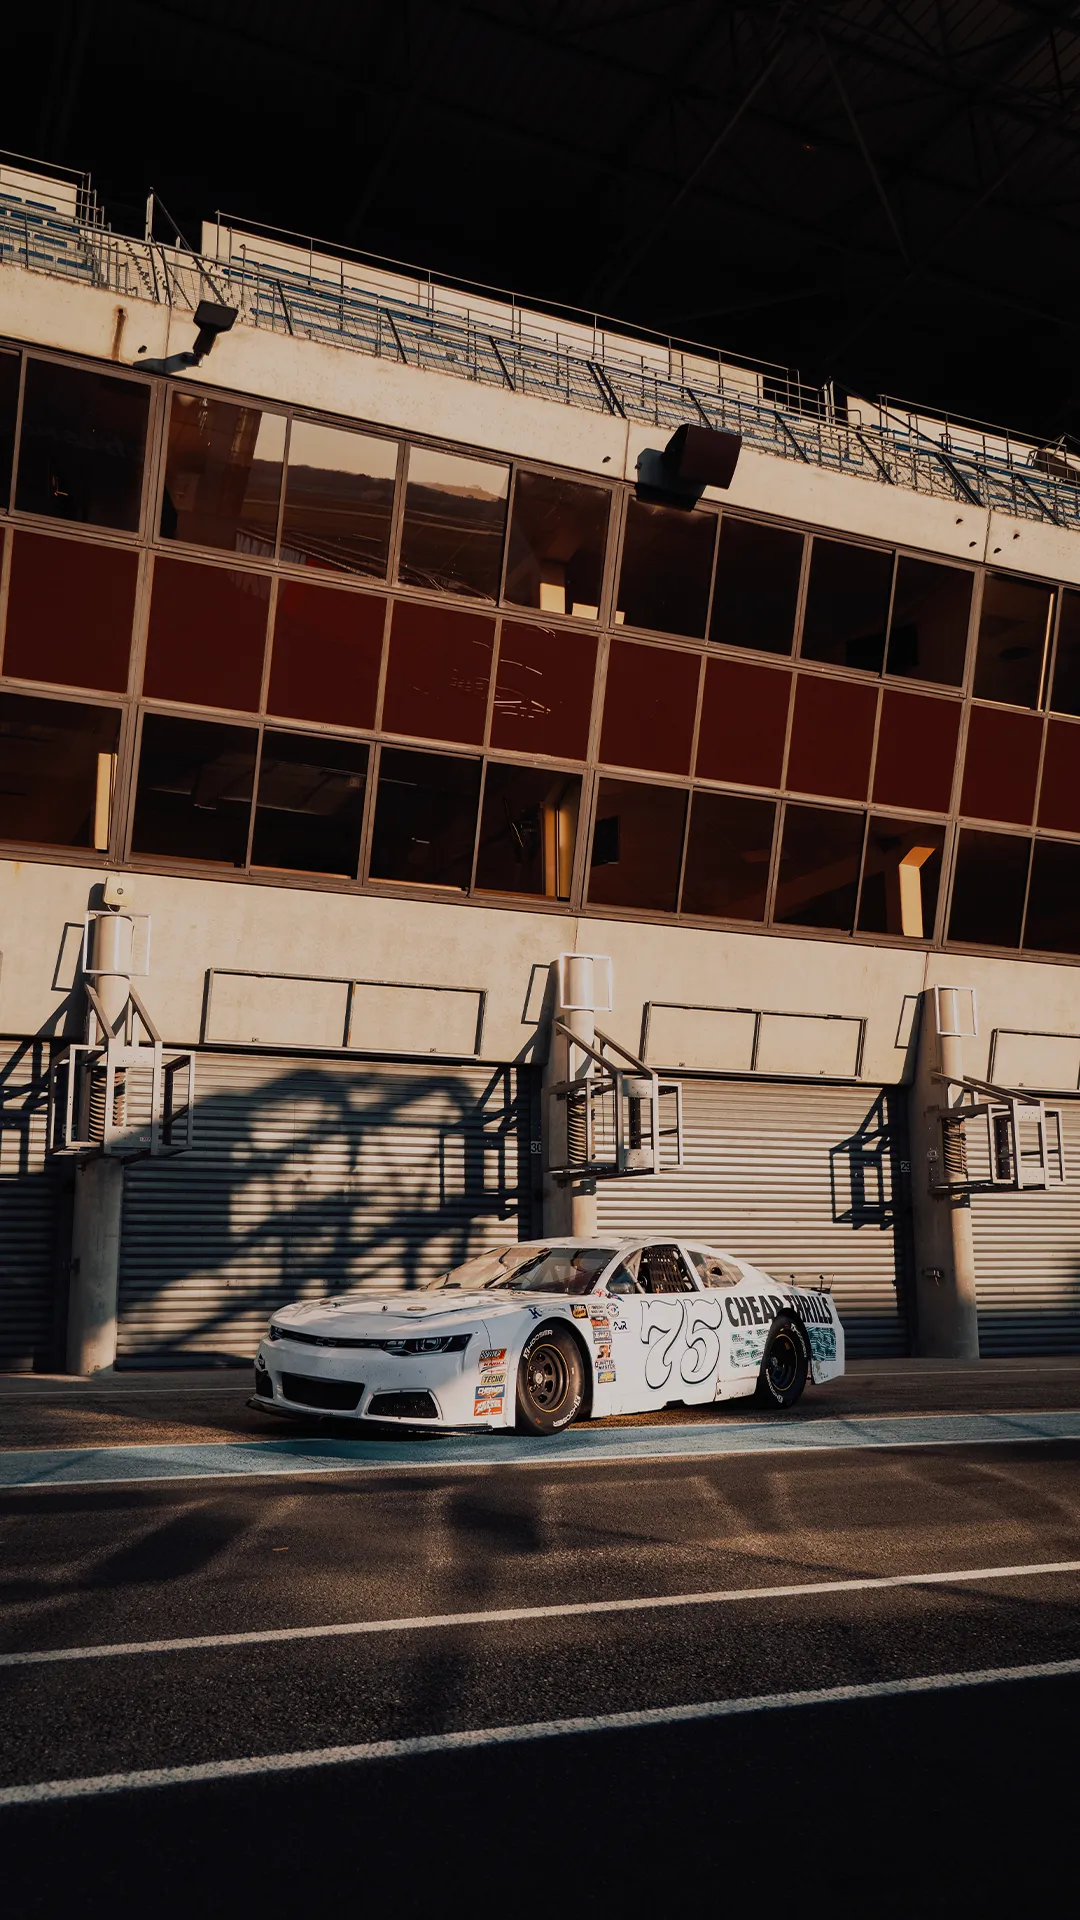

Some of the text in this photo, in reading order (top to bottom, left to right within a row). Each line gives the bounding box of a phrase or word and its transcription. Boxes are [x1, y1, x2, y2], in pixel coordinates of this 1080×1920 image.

[531, 1142, 542, 1153] 30
[901, 1161, 911, 1172] 29
[725, 1295, 784, 1328] CHEAP
[640, 1298, 723, 1389] 75
[484, 1375, 504, 1383] TECNO
